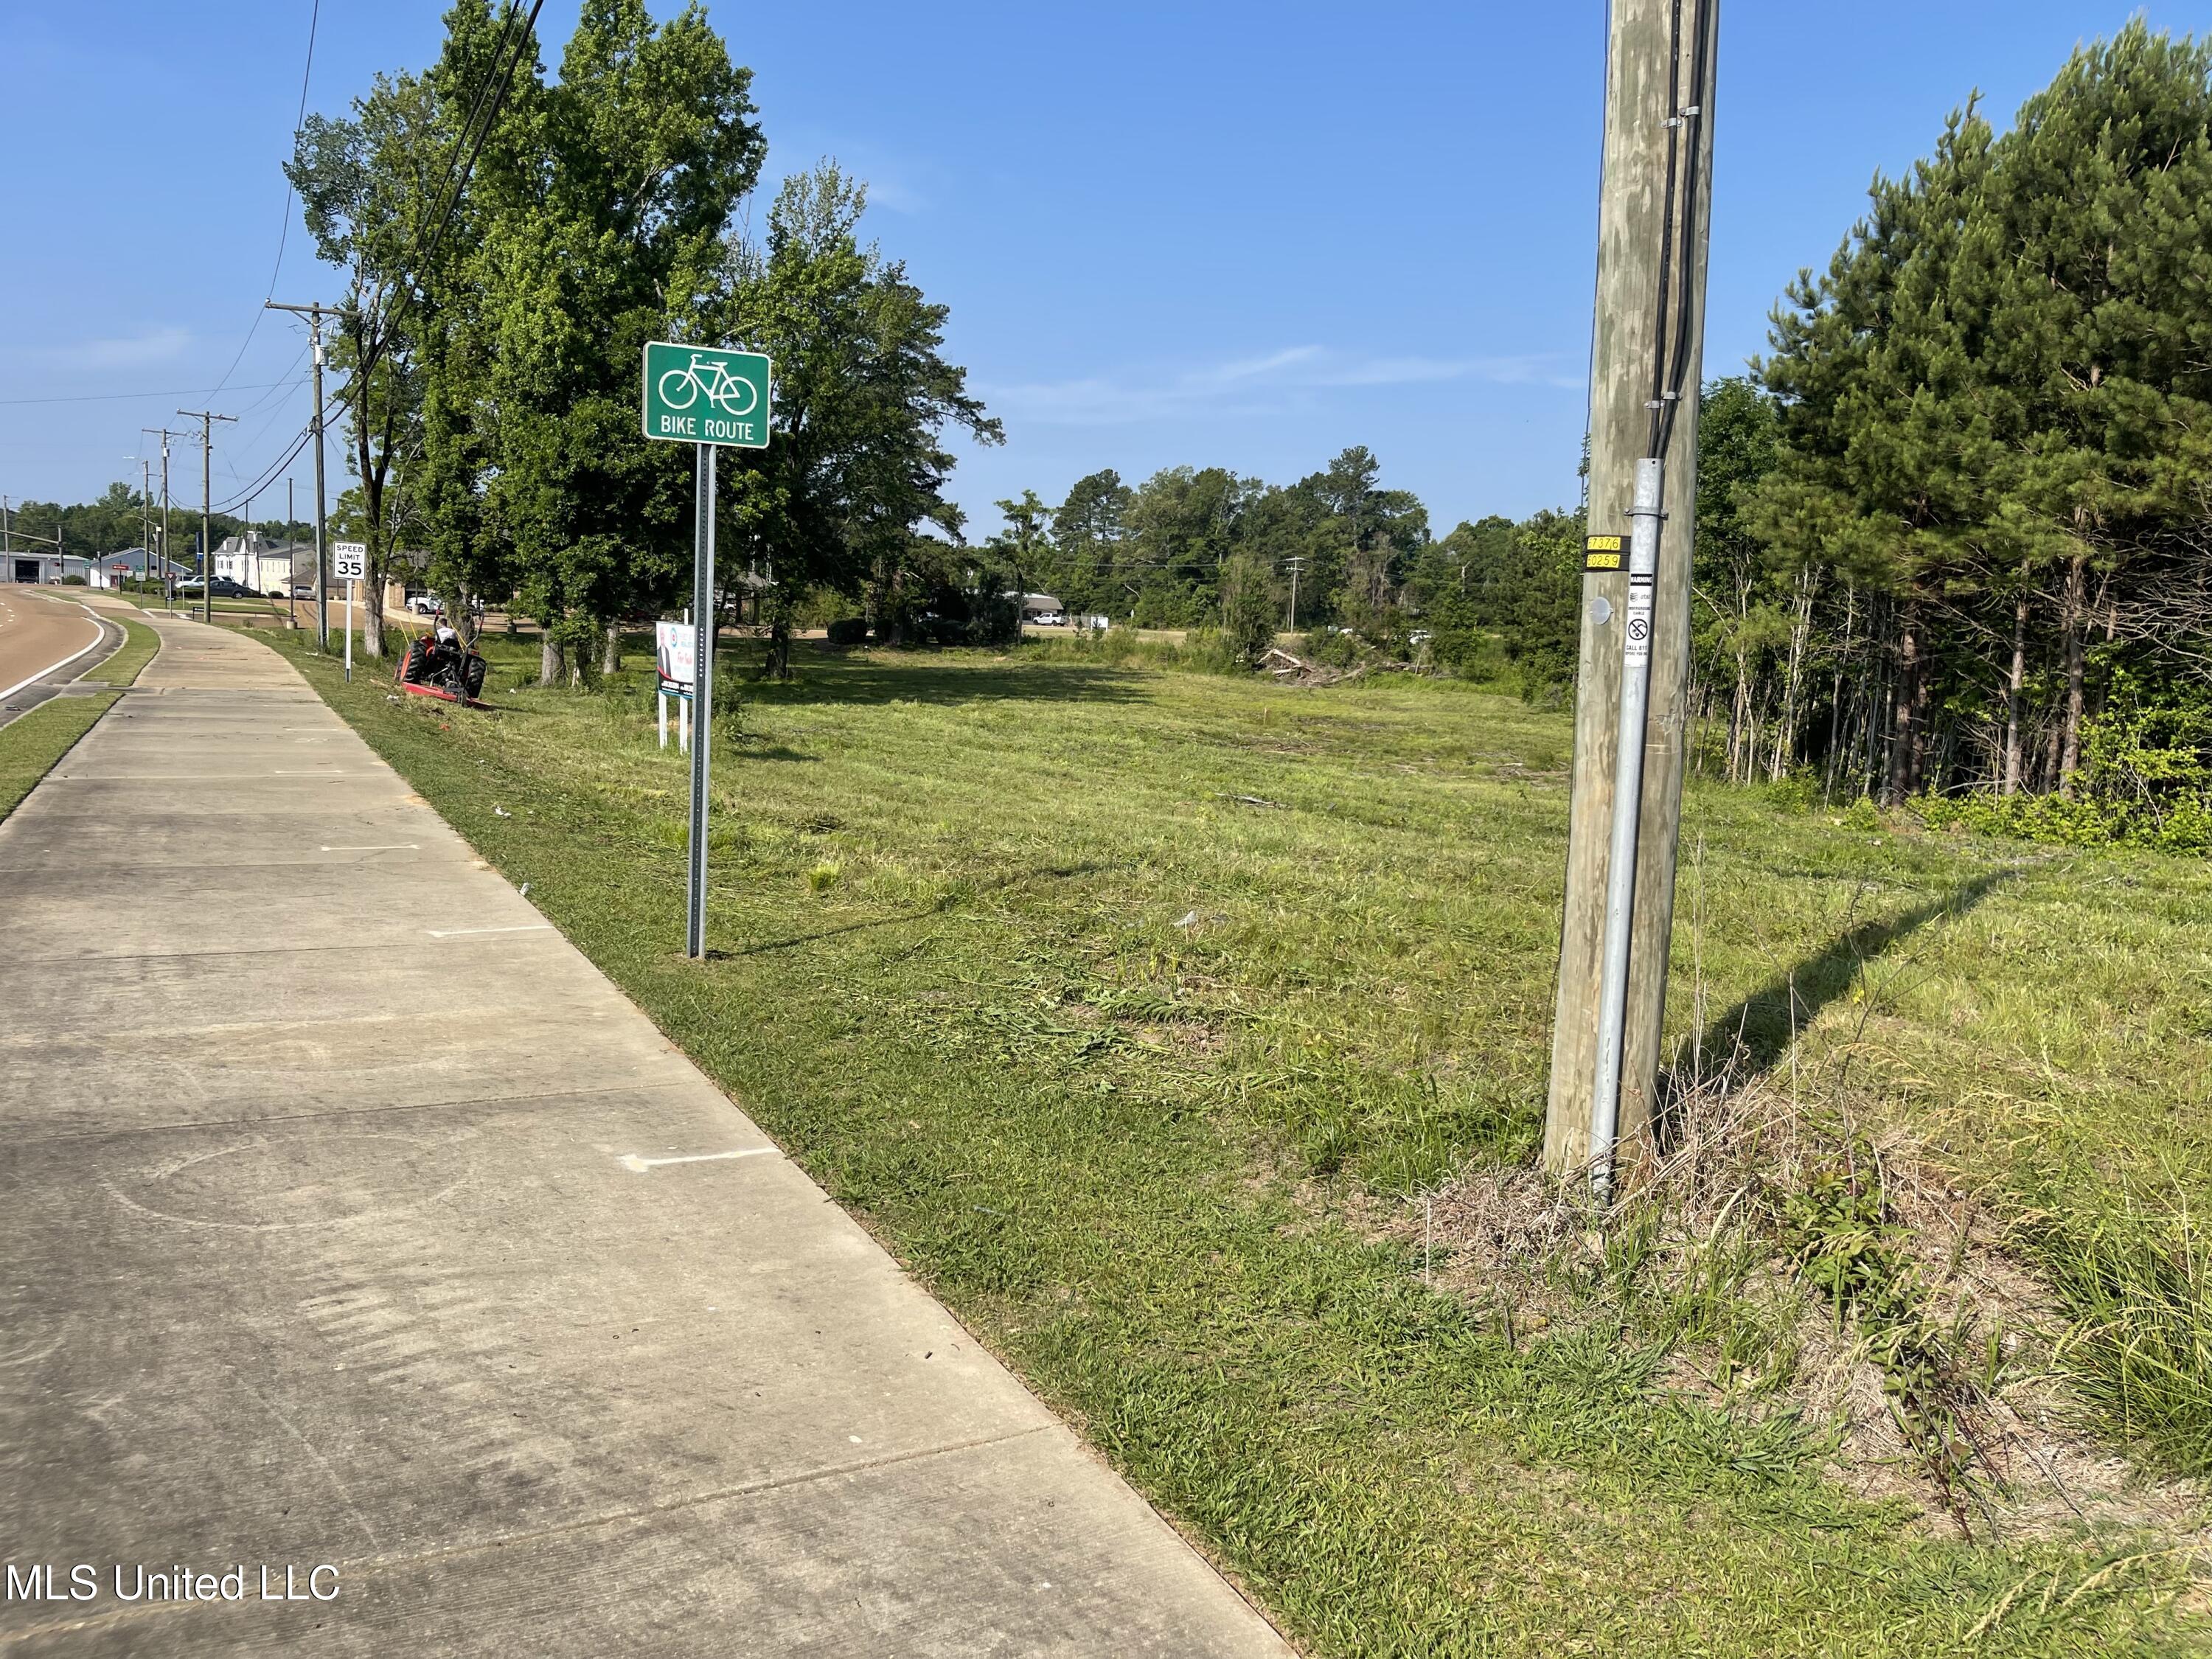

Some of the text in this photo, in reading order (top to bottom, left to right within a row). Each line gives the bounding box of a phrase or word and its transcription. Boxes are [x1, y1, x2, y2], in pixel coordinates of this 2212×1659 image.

[661, 415, 754, 440] BIKE ROUTE
[338, 561, 361, 575] 35
